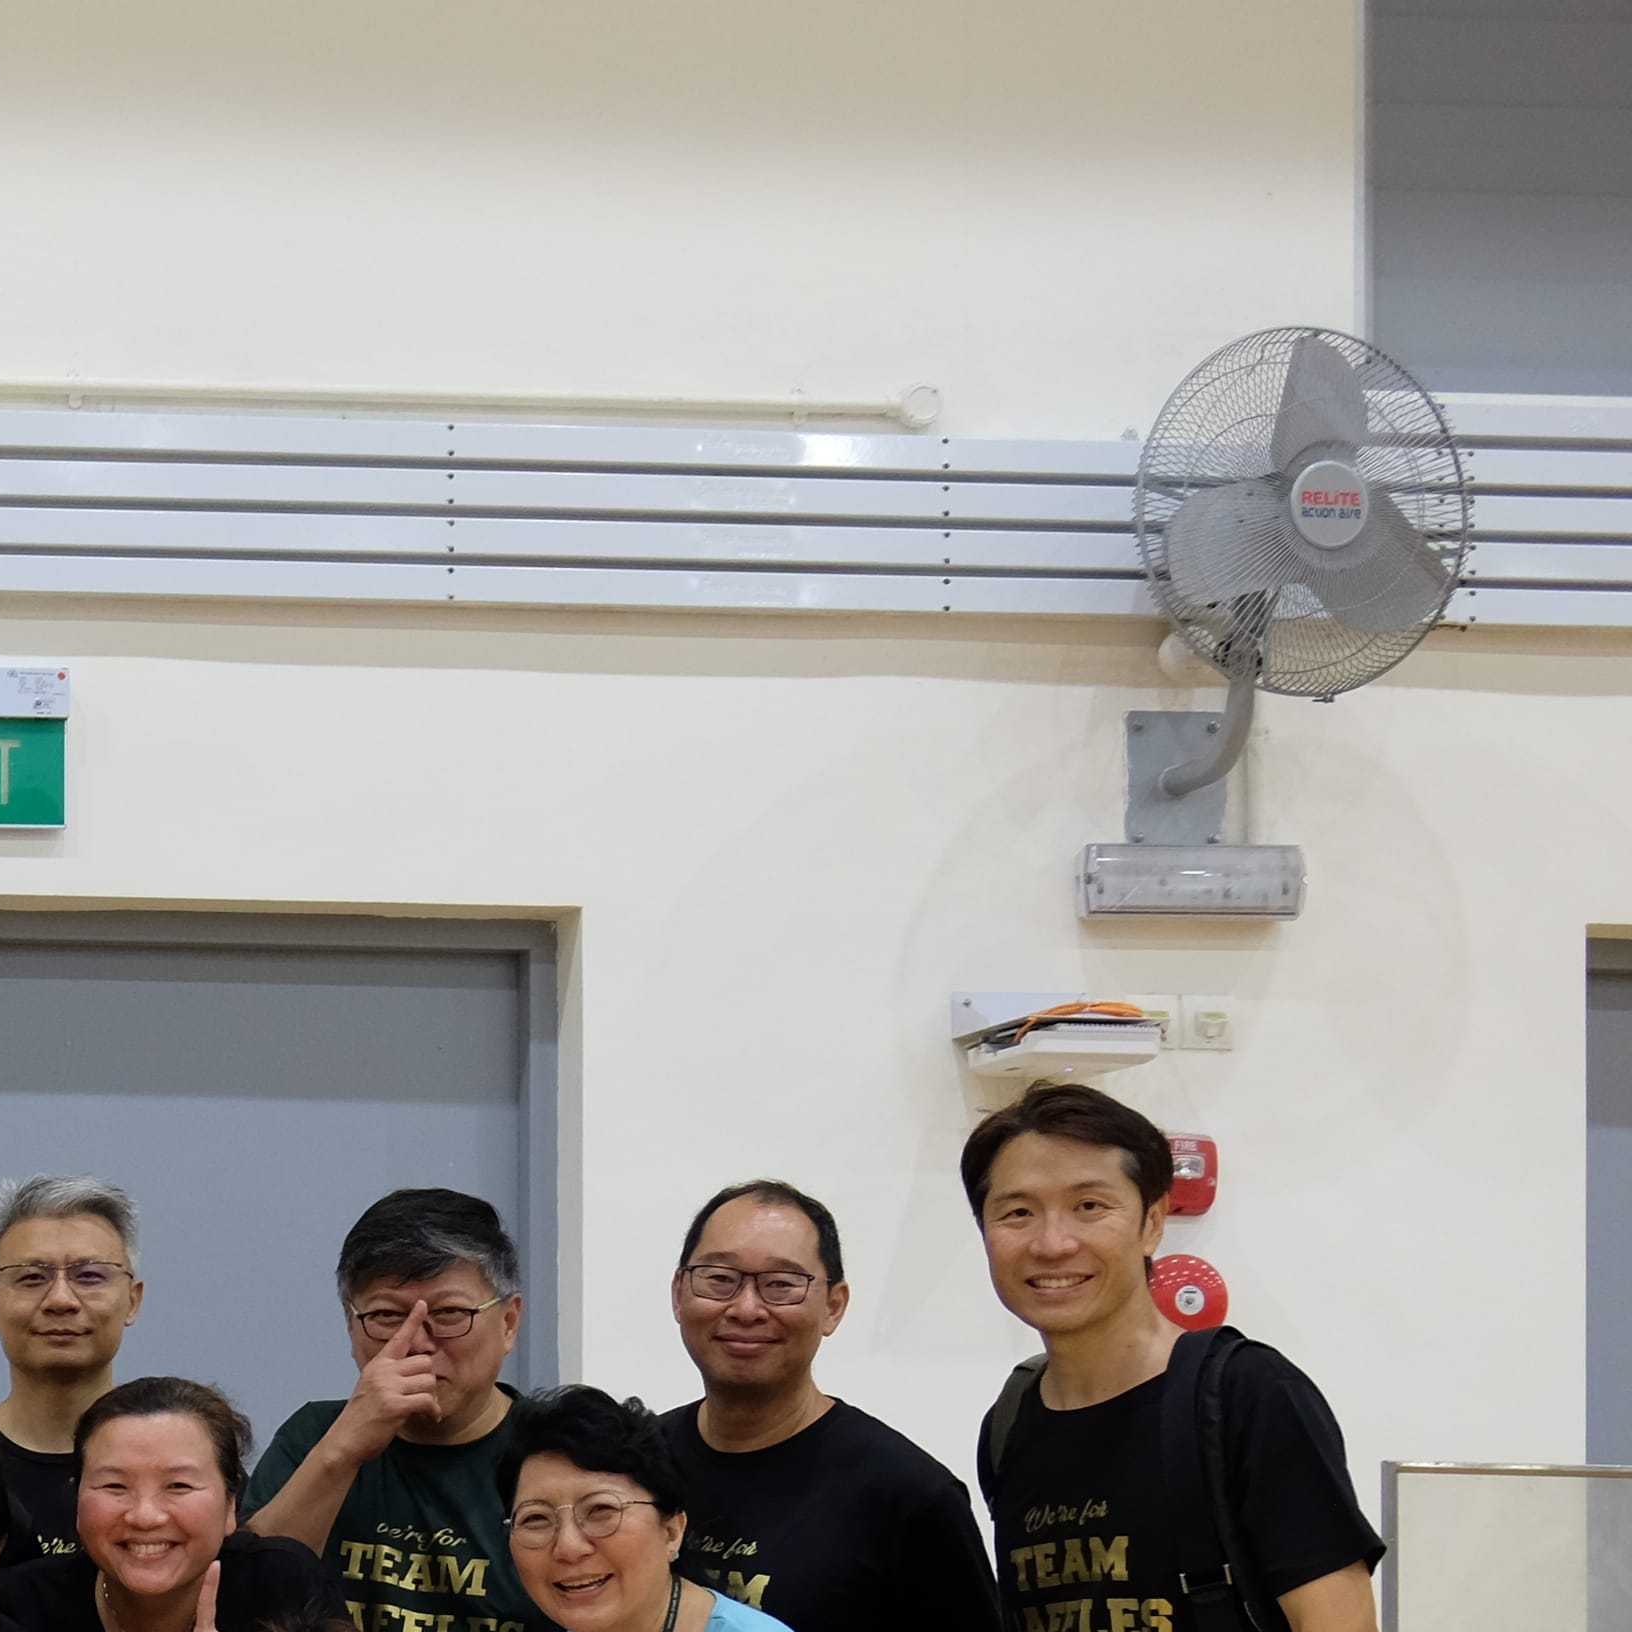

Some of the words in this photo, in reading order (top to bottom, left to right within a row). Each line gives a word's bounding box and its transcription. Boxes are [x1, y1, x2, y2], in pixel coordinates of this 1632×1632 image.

[1173, 1139, 1198, 1151] FIRE
[1078, 1498, 1110, 1526] for
[429, 1527, 469, 1550] for
[721, 1536, 759, 1560] for
[339, 1539, 491, 1598] TEAM
[1009, 1535, 1130, 1592] TEAM
